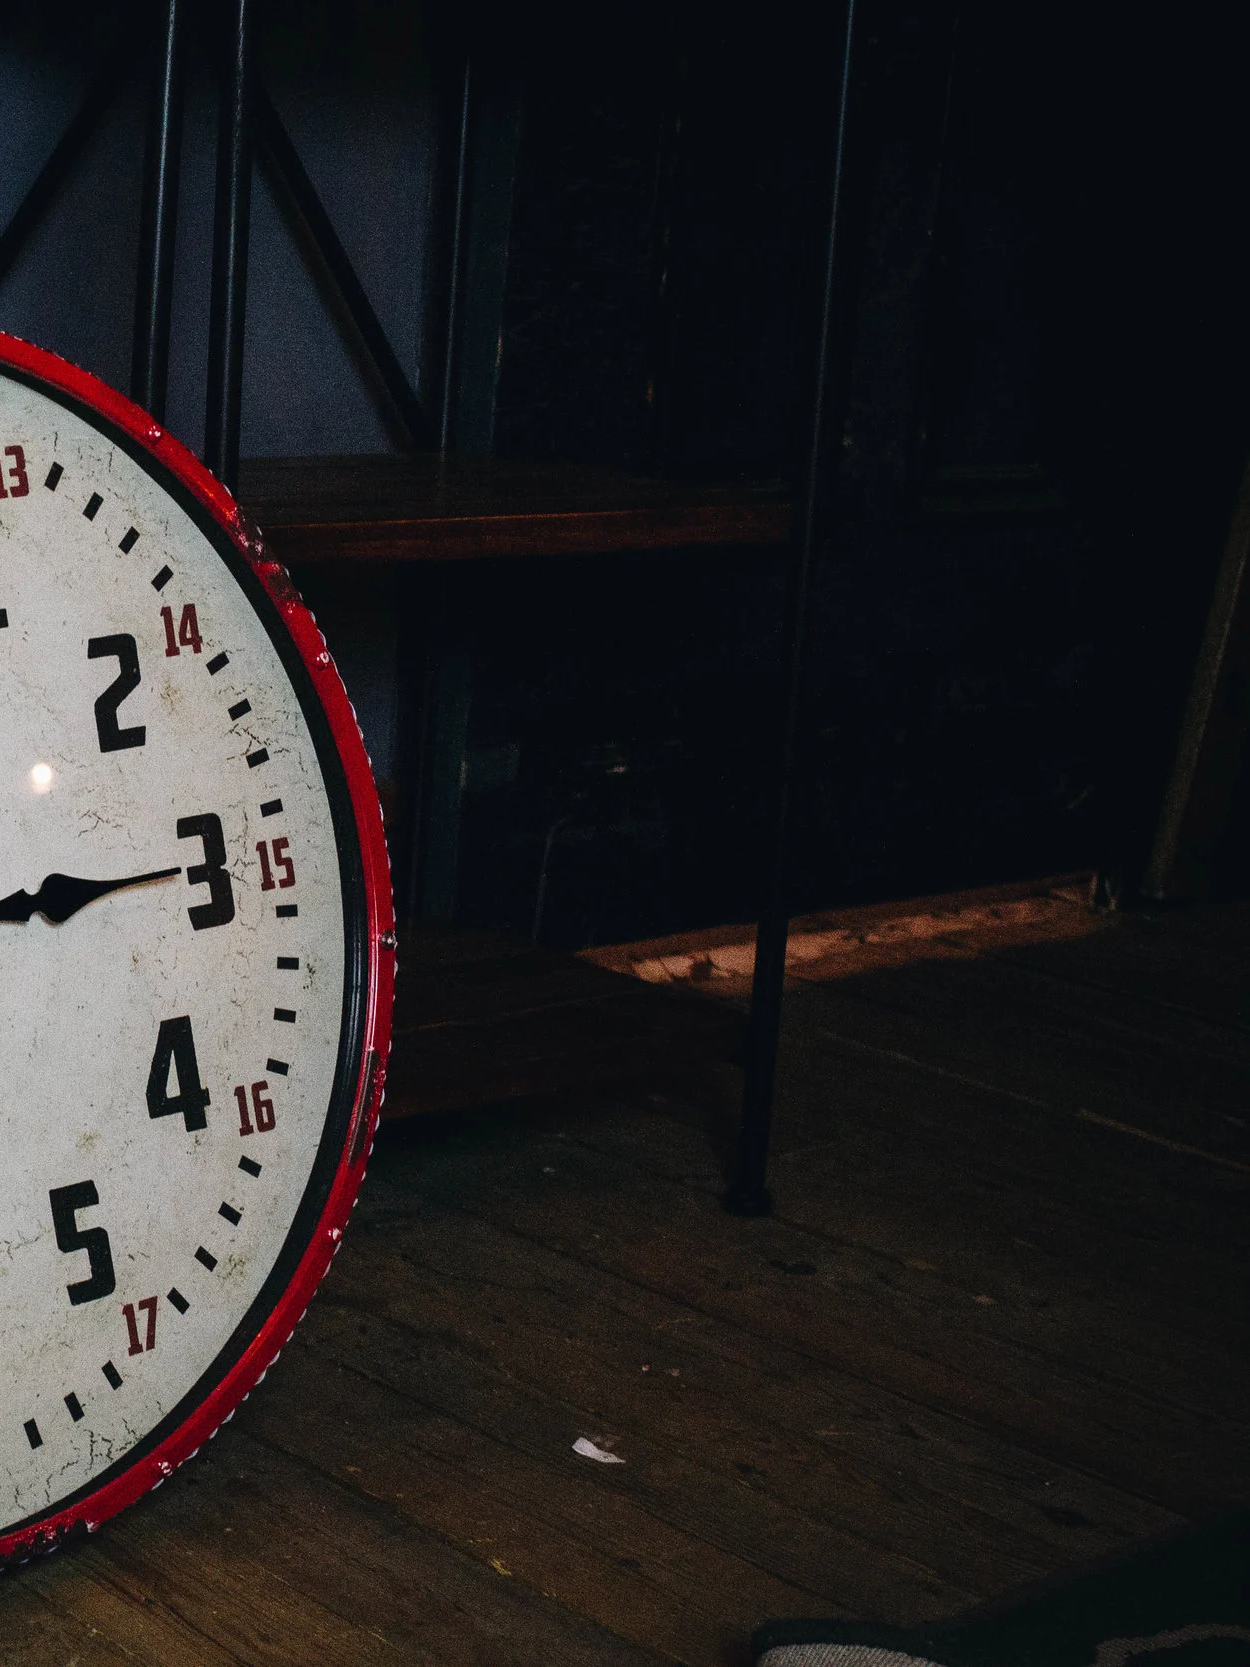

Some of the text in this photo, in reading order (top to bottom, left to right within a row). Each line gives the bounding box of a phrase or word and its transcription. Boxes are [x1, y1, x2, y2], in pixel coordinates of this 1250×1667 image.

[160, 603, 203, 657] 14
[88, 633, 146, 753] 2
[177, 813, 235, 931] 3
[256, 837, 295, 891] 15
[146, 1015, 211, 1132] 4
[234, 1080, 276, 1137] 16
[49, 1180, 116, 1306] 5
[122, 1296, 158, 1356] 17
